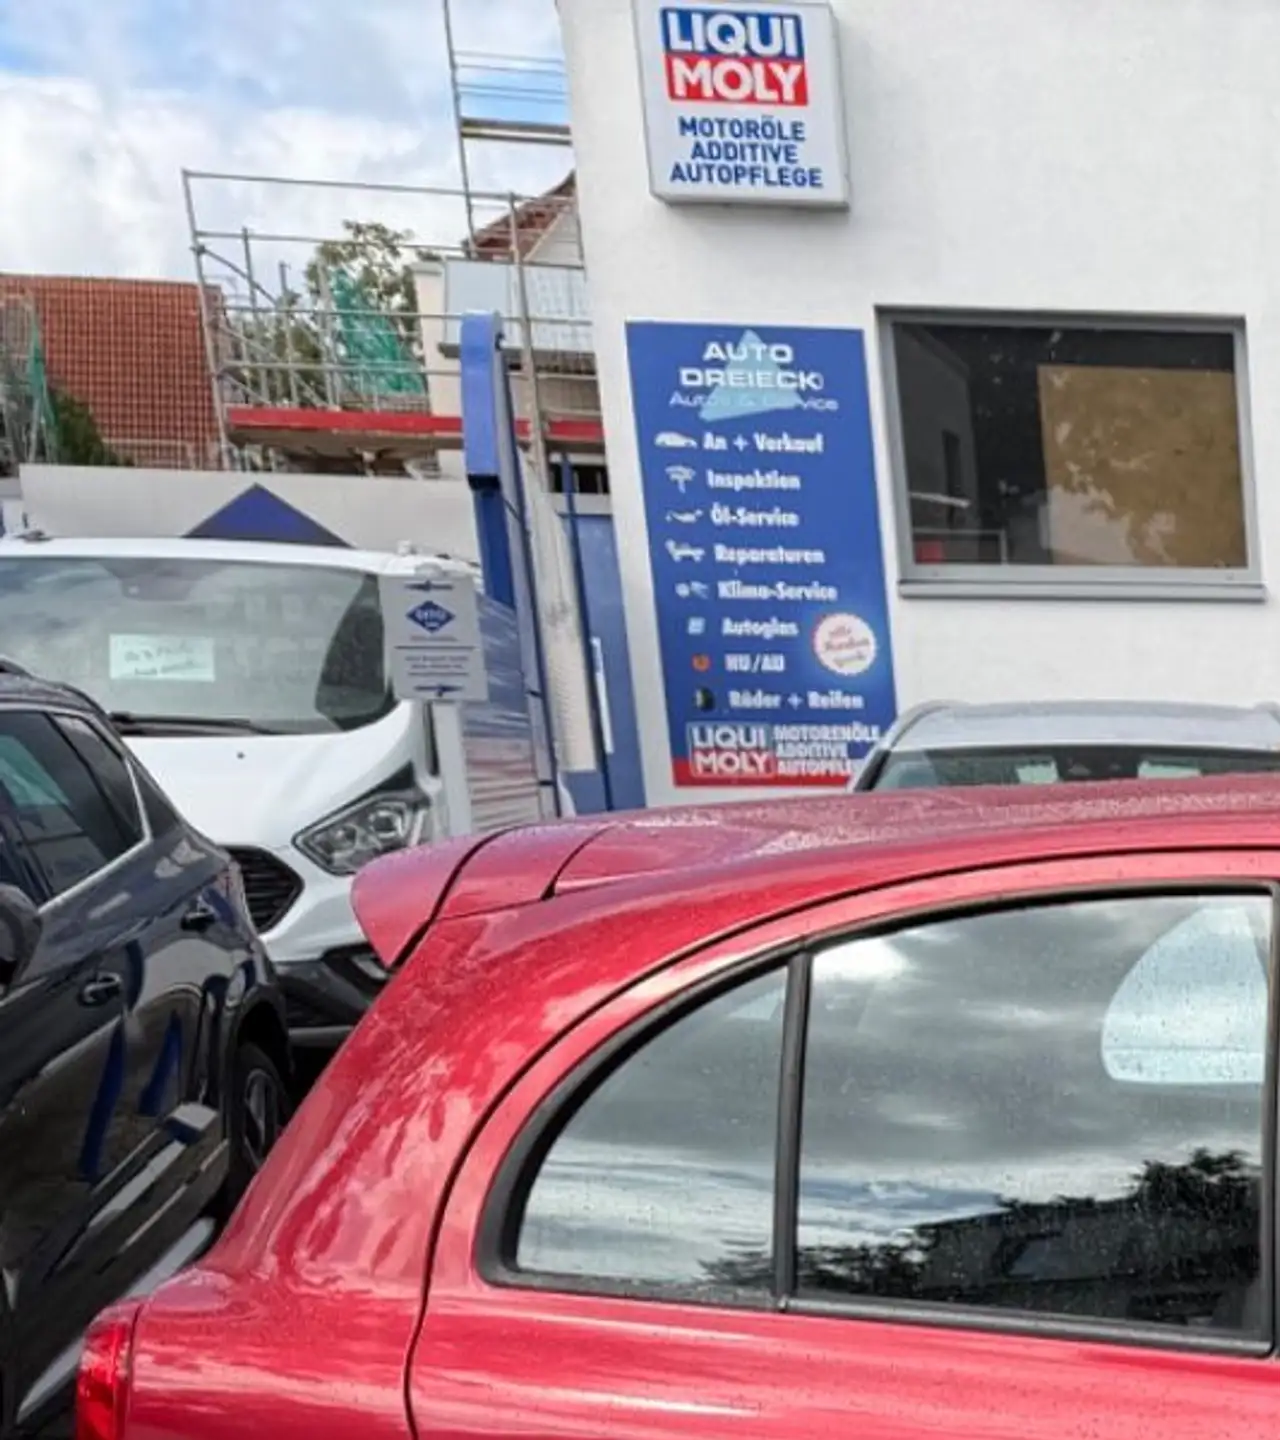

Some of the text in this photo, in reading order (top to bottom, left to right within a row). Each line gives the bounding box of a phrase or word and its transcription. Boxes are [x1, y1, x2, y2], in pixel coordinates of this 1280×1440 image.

[666, 11, 798, 57] LIQUI
[671, 58, 802, 102] MOLY
[678, 115, 806, 142] MOTORÖLE
[690, 142, 799, 165] ADDITIVE
[669, 163, 824, 188] AUTOPFLEGE
[702, 341, 794, 363] AUTO
[679, 367, 824, 391] DREIECK
[703, 431, 824, 453] An + Verkauf
[706, 468, 801, 493] Inspektion
[710, 502, 799, 527] Öl-Service
[714, 543, 826, 566] Reparaturen
[717, 580, 838, 601] Klima-Service
[728, 688, 865, 710] Räder + Reifen
[691, 725, 768, 749] LIQUI
[693, 750, 770, 776] MOLY
